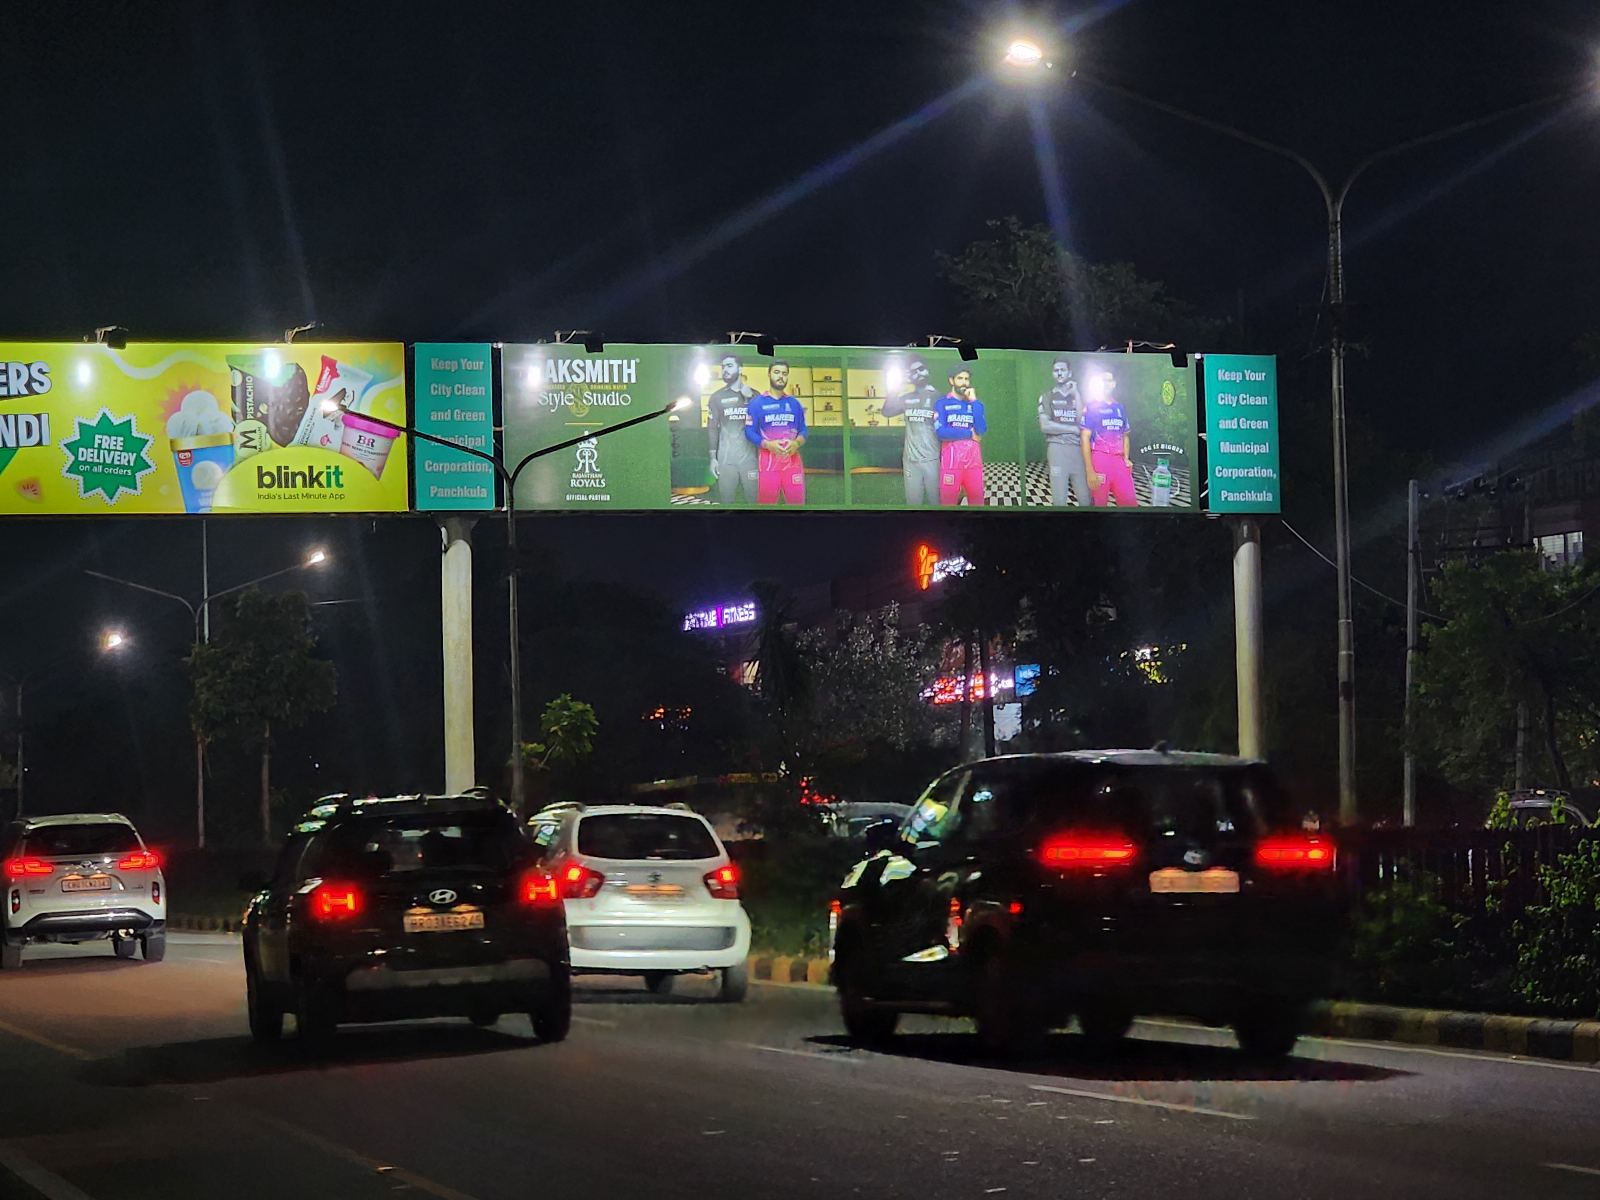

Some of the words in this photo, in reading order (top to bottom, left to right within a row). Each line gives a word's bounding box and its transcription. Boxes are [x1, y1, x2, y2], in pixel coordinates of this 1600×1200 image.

[431, 358, 458, 372] Keep
[461, 358, 484, 371] Your
[530, 359, 637, 384] AKSMITH
[1217, 369, 1243, 383] Keep
[1245, 369, 1266, 381] Your
[246, 375, 255, 419] PISTACHIO
[430, 383, 452, 397] City
[454, 383, 486, 396] Clean
[538, 391, 574, 413] Style
[582, 391, 632, 406] Studio
[1217, 393, 1238, 407] City
[1239, 393, 1268, 405] Clean
[430, 408, 451, 422] and
[453, 408, 486, 422] Green
[1218, 418, 1238, 430] and
[1239, 417, 1269, 430] Green
[0, 414, 50, 448] NDI
[94, 434, 124, 451] FREE
[431, 434, 486, 448] nicipal
[1219, 441, 1270, 455] Municipal
[78, 447, 137, 466] DELIVERY
[79, 464, 90, 472] on
[92, 464, 102, 473] all
[104, 466, 132, 476] orders
[257, 465, 344, 489] blinkit
[1215, 465, 1277, 479] Corporation,
[570, 479, 606, 488] ROYALS
[257, 492, 282, 500] India's
[283, 492, 300, 500] Last
[301, 492, 327, 500] Minute
[329, 492, 345, 501] App
[430, 485, 487, 498] Panchkula
[1221, 490, 1273, 502] Panchkula
